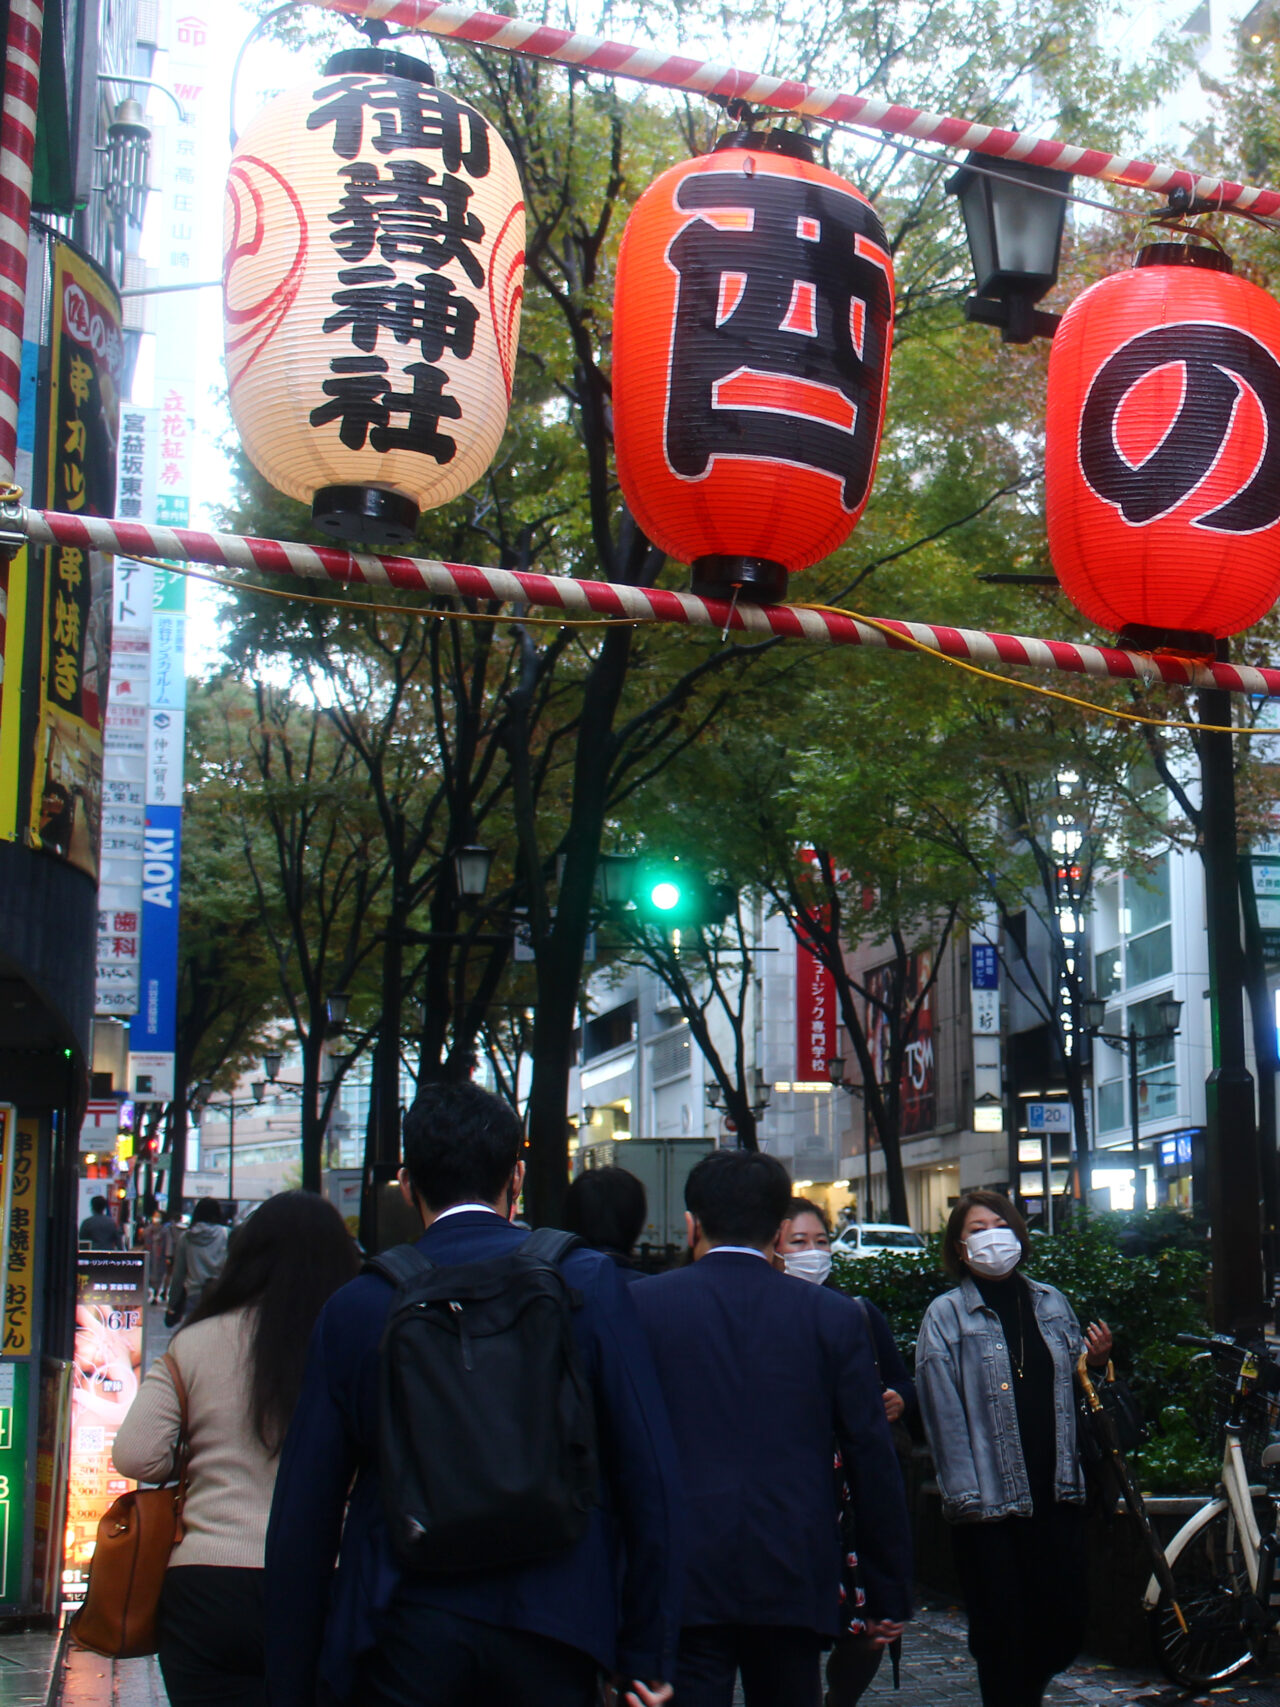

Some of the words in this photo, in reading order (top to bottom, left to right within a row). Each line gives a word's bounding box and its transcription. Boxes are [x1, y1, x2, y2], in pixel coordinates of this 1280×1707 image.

[142, 828, 175, 909] AOKI
[112, 912, 138, 959] 歯科
[904, 1039, 934, 1089] TSM
[3, 1283, 27, 1349] おでん
[107, 1311, 140, 1331] 6F
